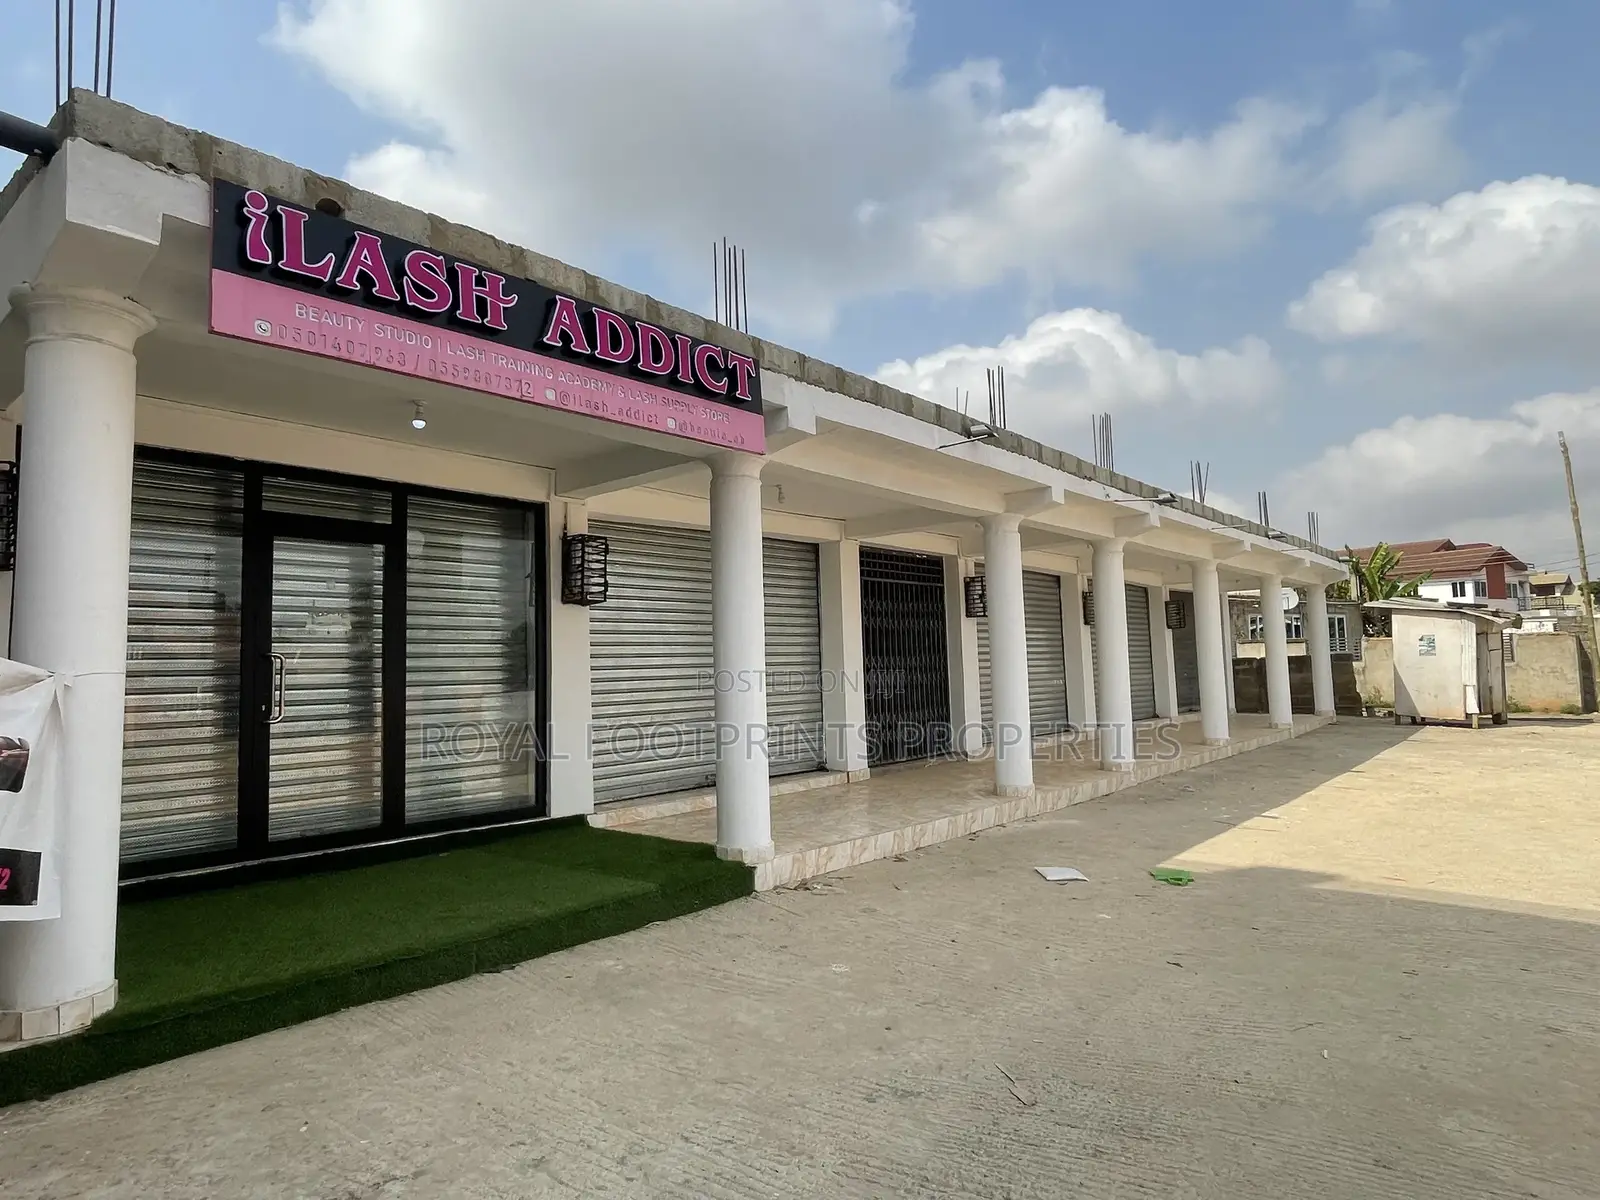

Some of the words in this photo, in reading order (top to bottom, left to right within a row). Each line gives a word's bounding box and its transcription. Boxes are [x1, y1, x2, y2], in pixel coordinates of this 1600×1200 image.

[243, 189, 519, 331] iLASH
[543, 295, 756, 400] ADDICT
[295, 302, 366, 332] BEAUTY
[374, 322, 432, 349] STUDIO
[447, 340, 486, 362] LASH
[491, 352, 554, 380] TRAINING
[558, 370, 615, 395] ACADEMY
[618, 386, 626, 398] &
[628, 388, 658, 405] LASH
[661, 396, 699, 416] SUPPLY
[701, 407, 731, 425] STORE
[414, 353, 420, 373] /
